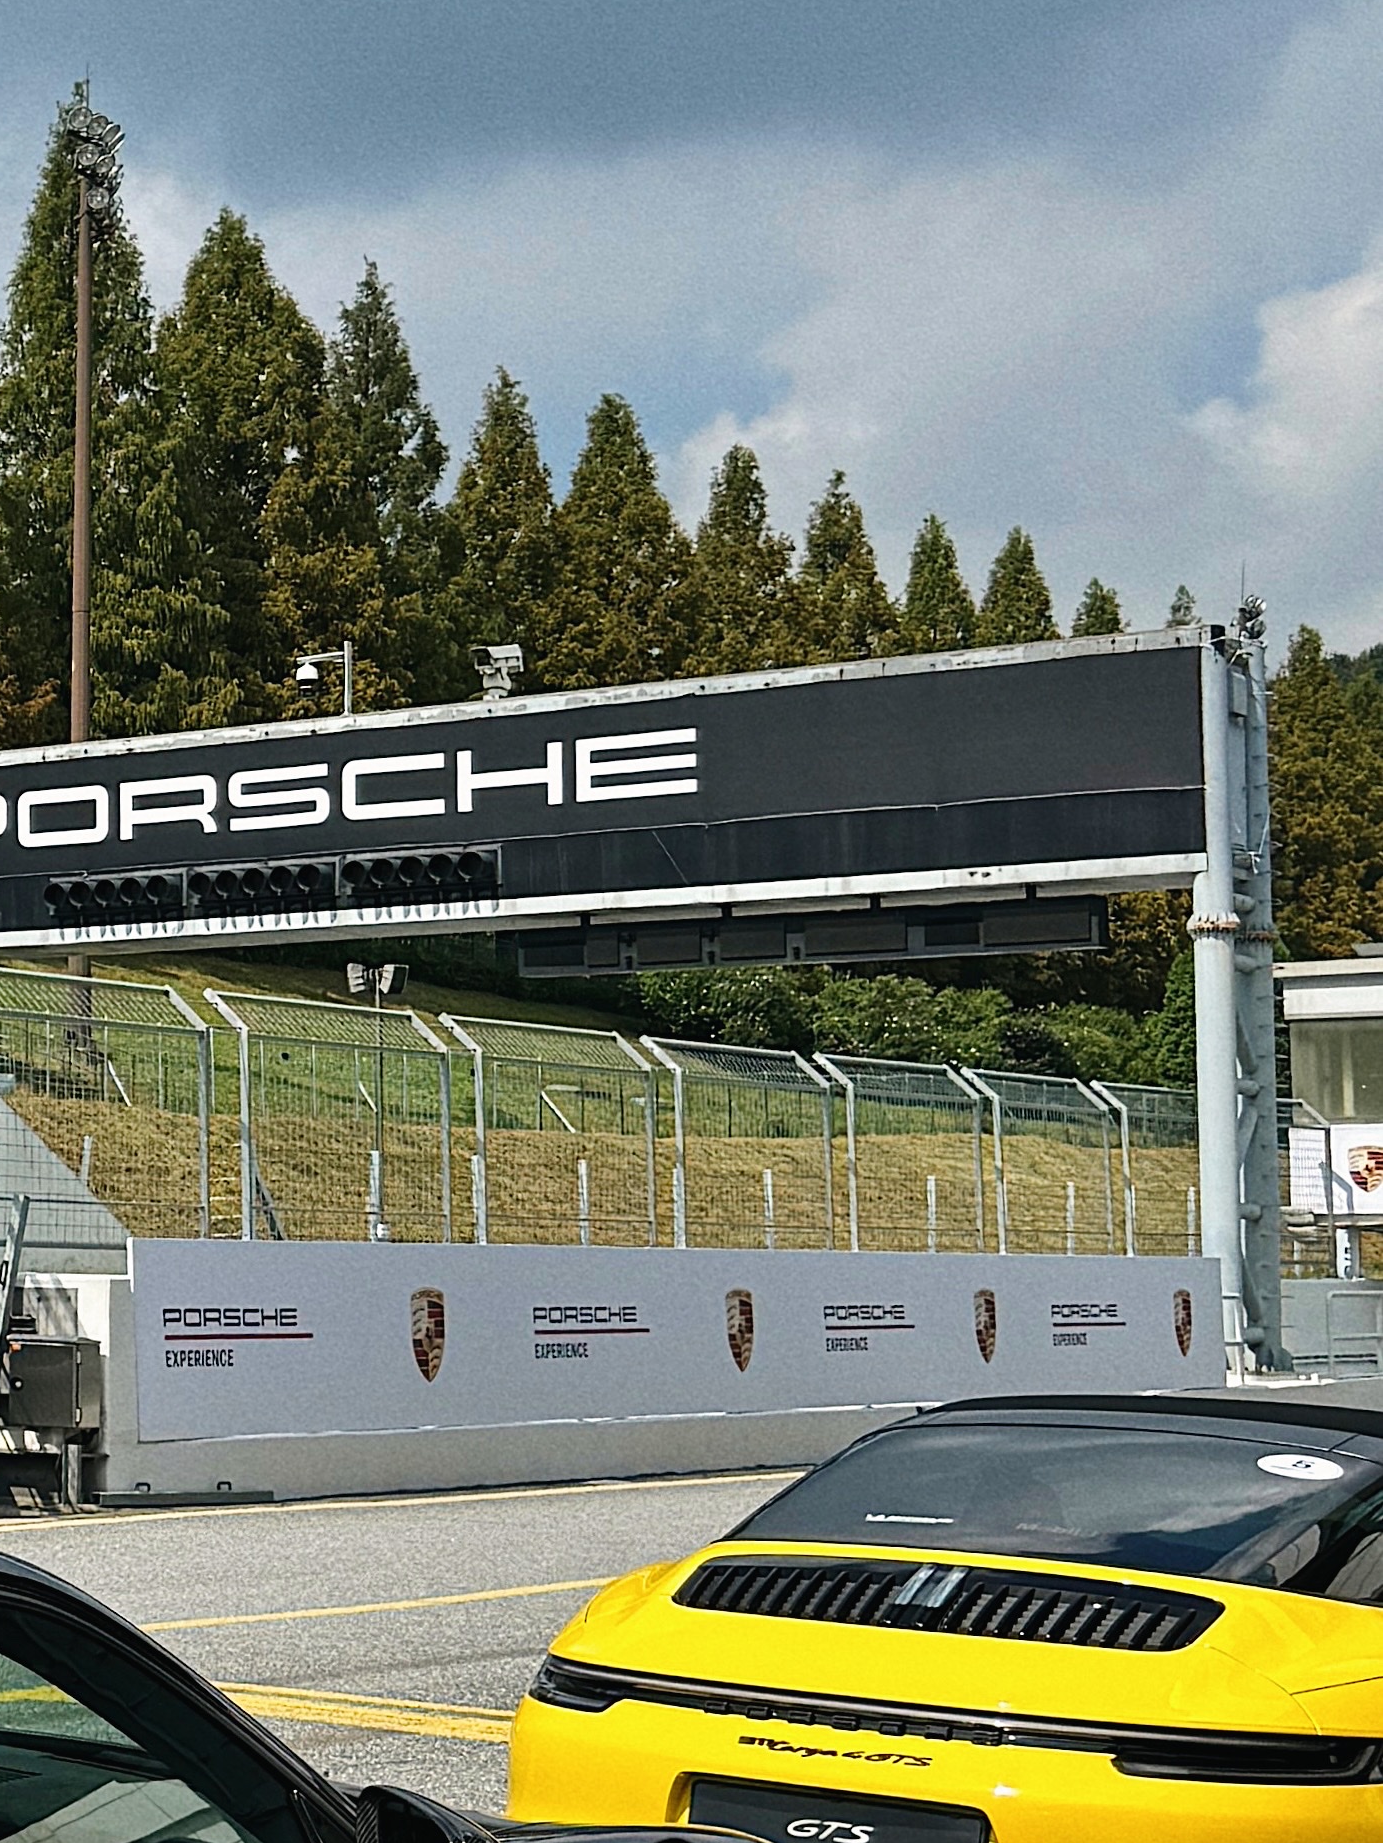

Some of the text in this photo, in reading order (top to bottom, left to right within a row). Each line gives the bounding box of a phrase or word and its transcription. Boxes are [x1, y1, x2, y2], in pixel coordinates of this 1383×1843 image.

[162, 1307, 298, 1328] PORSCHE
[532, 1305, 638, 1324] PORSCHE
[165, 1348, 234, 1368] EXPERIENCE
